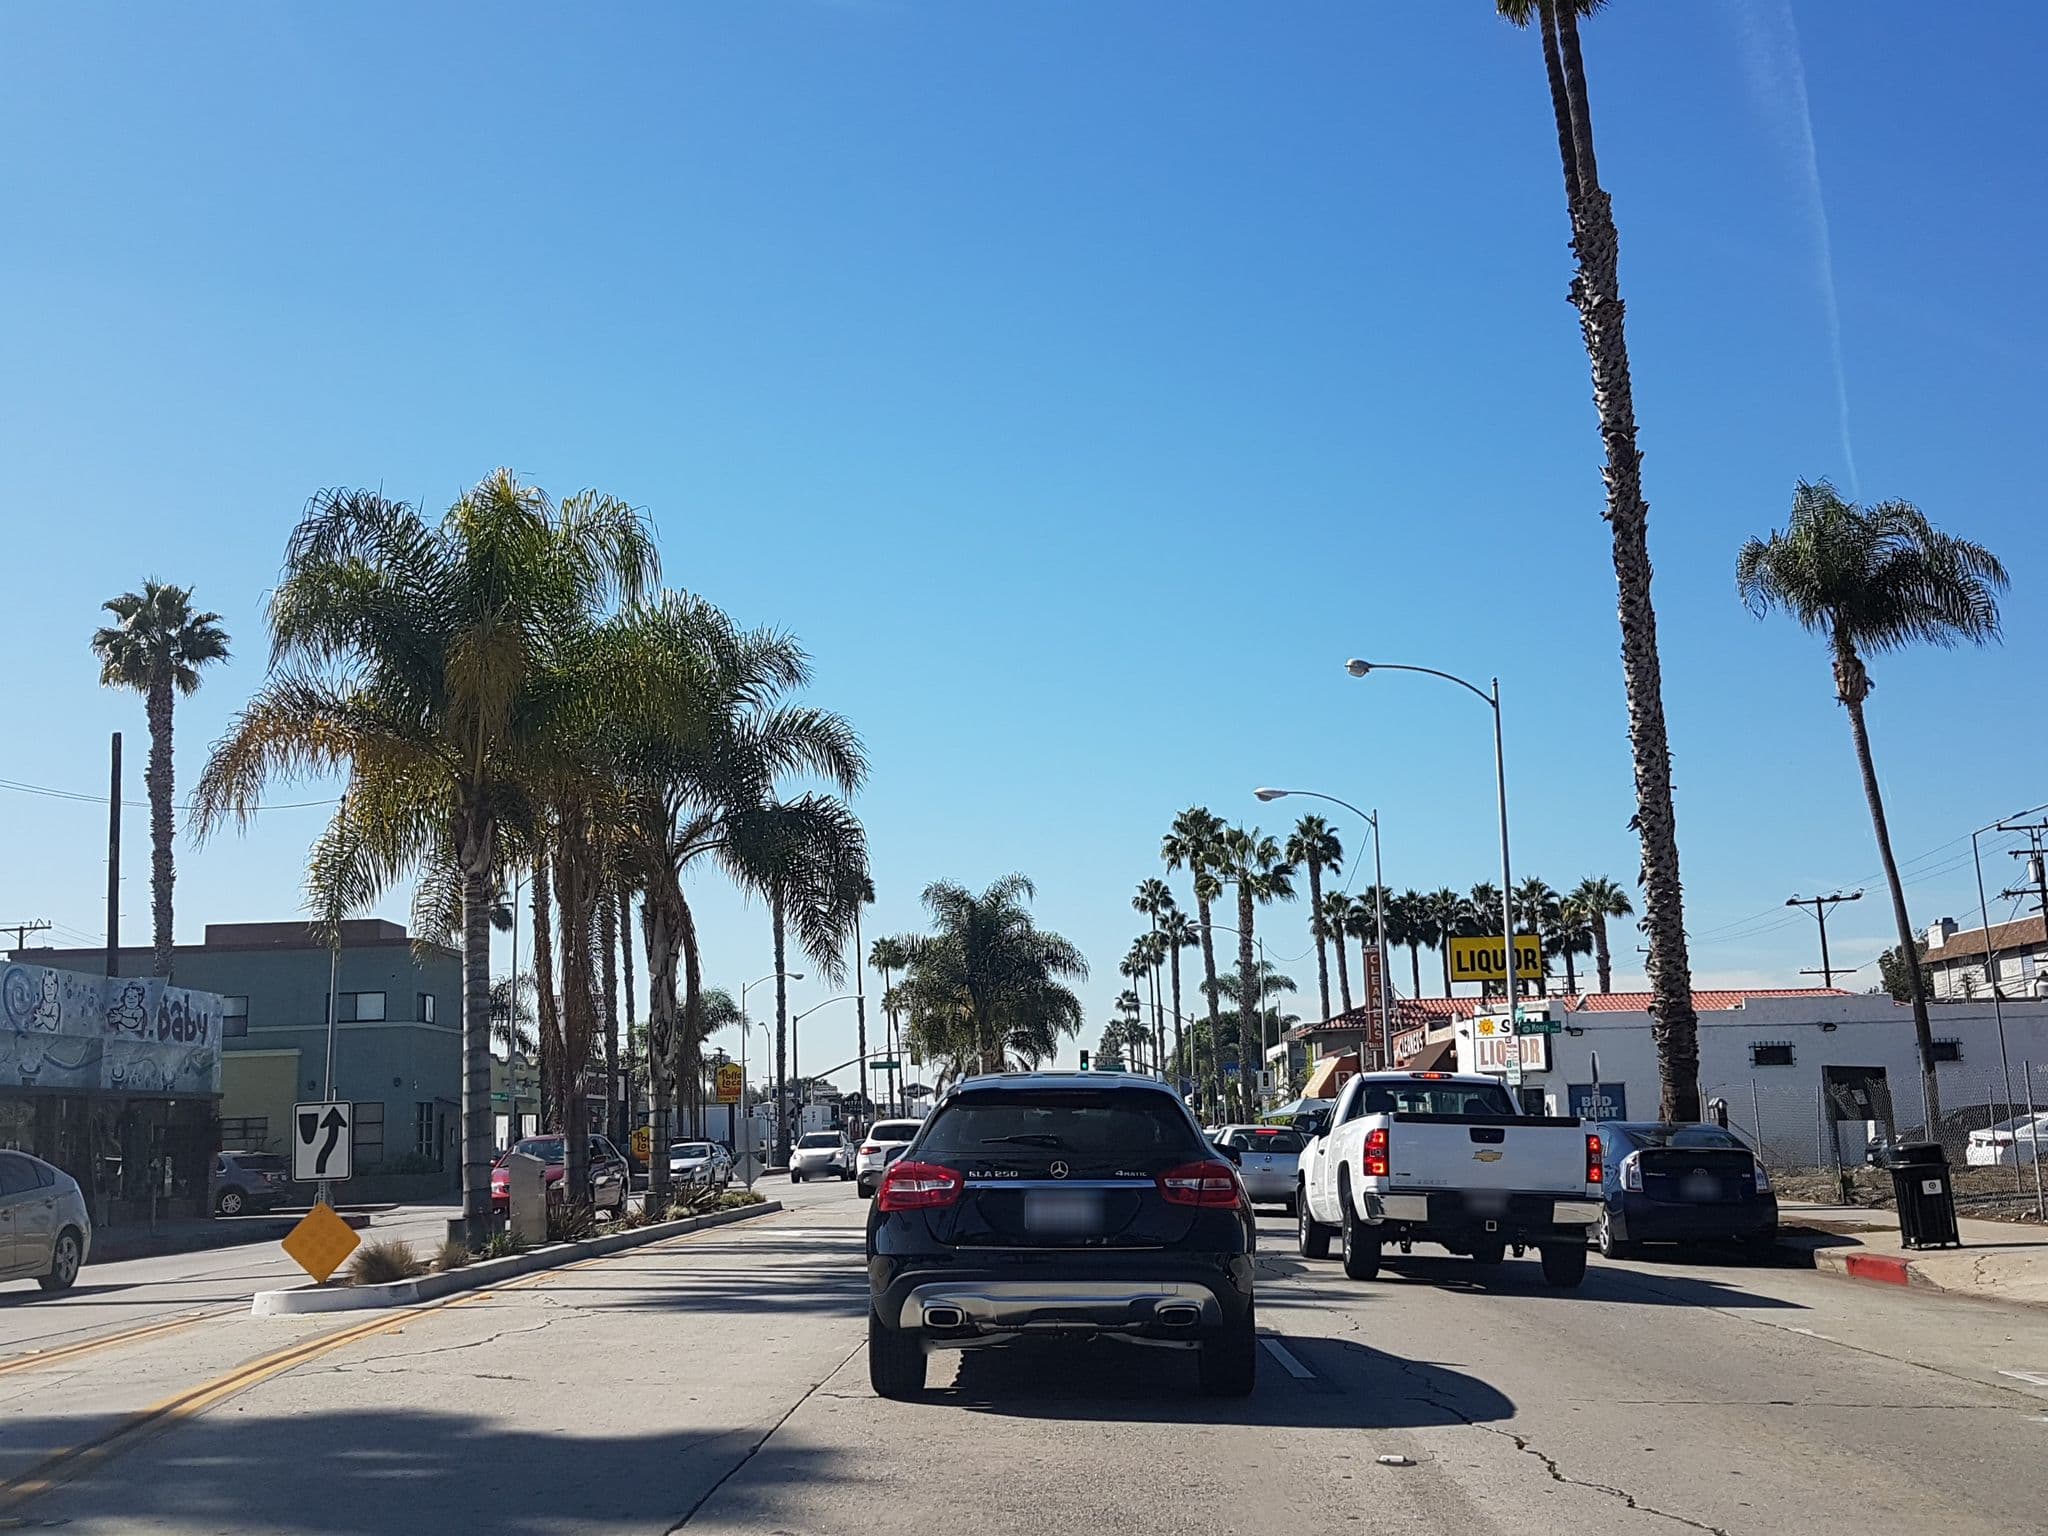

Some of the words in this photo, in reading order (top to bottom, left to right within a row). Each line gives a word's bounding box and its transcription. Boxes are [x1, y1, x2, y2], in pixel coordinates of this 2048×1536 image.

[1369, 955, 1383, 1040] CLEANERS
[1480, 1038, 1541, 1067] LIQOR
[994, 1170, 1019, 1178] 250
